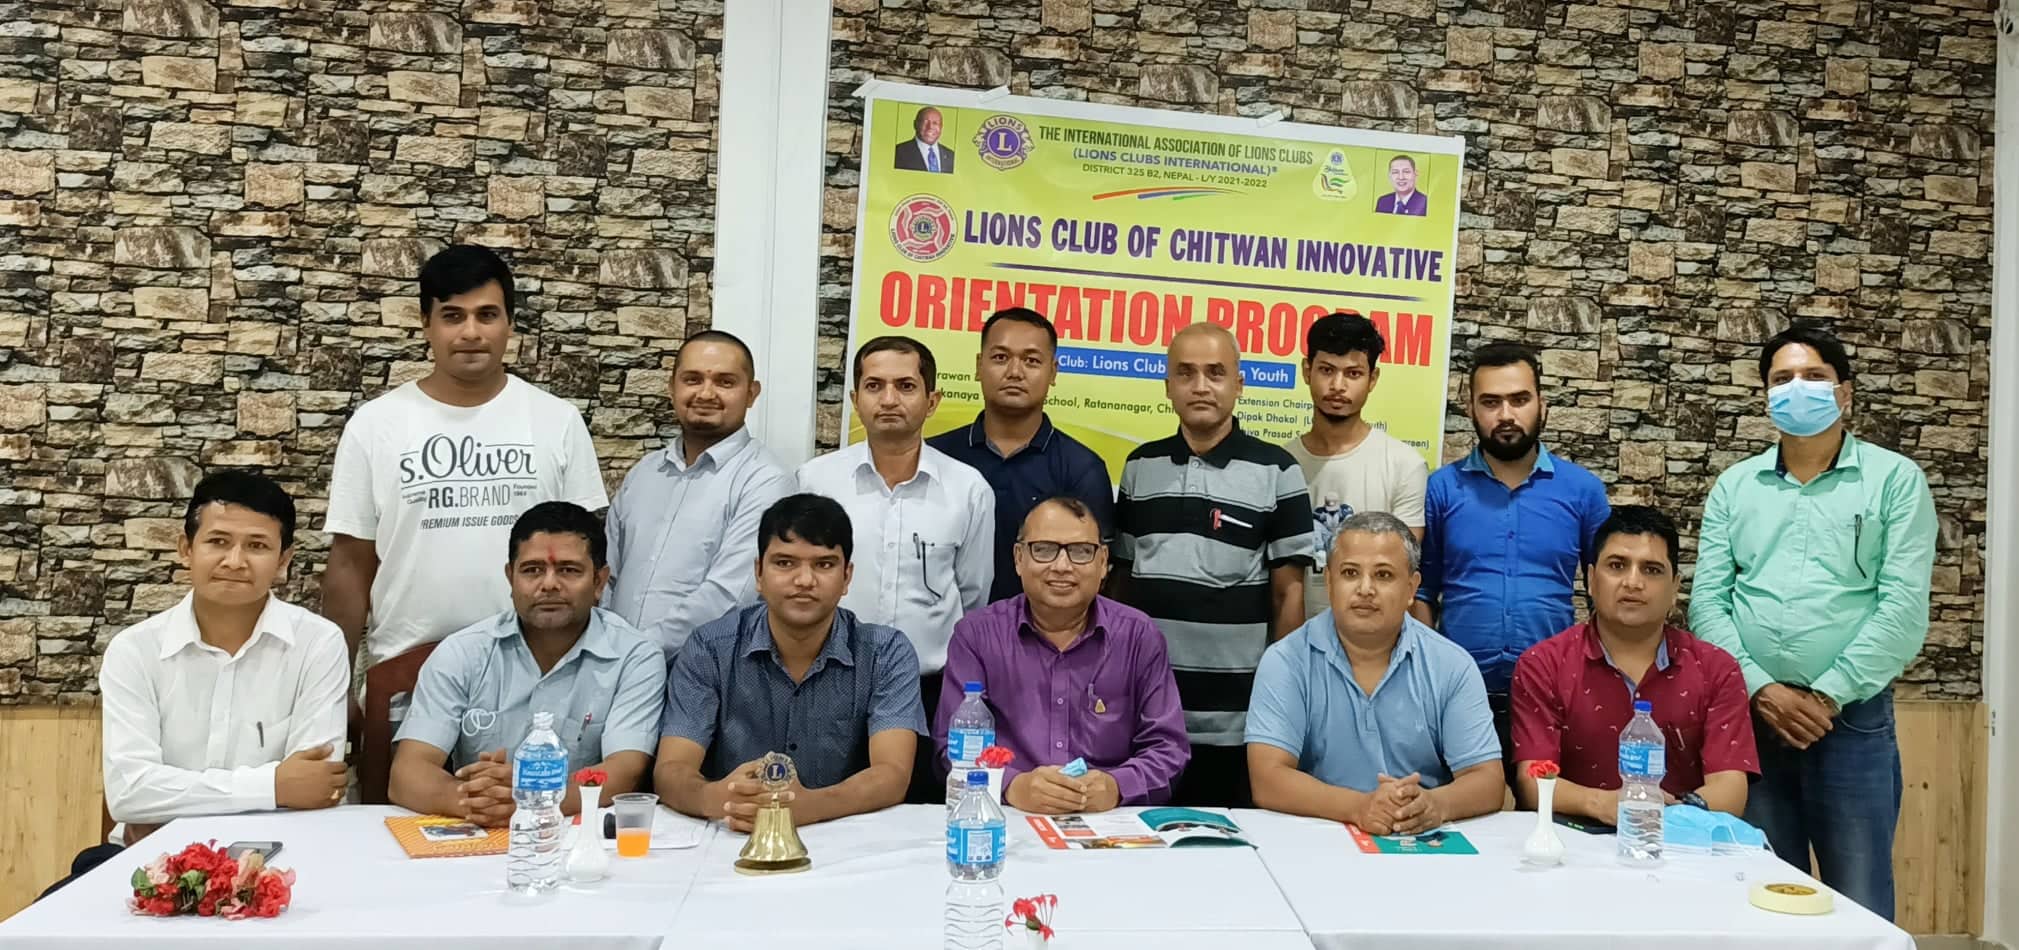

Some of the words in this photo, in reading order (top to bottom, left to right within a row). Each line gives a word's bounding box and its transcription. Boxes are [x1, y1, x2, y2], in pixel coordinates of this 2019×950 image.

[988, 117, 1022, 131] LIONS
[997, 132, 1012, 151] L
[1038, 126, 1061, 142] THE
[1063, 129, 1151, 150] INTERNATIONAL
[1153, 136, 1227, 157] ASSOCIATION
[1228, 144, 1243, 159] OF
[1244, 145, 1276, 162] LIONS
[1278, 149, 1313, 165] CLUBS
[1073, 147, 1117, 162] (LIONS
[1120, 151, 1161, 165] CLUBS
[1082, 163, 1125, 176] DISTRICT
[1126, 166, 1145, 177] 325
[1146, 169, 1162, 179] B2,
[1163, 171, 1194, 182] NEPAL
[1201, 174, 1216, 183] L/Y
[1217, 176, 1268, 188] 2021-2022
[963, 210, 1042, 249] LIONS
[1051, 218, 1118, 255] CLUB
[1127, 225, 1161, 258] OF
[1169, 228, 1288, 270] CHITWAN
[1296, 239, 1444, 282] INNOVATIVE
[1057, 354, 1089, 369] Club:
[1092, 355, 1129, 373] Lions
[1133, 358, 1168, 375] Club
[1251, 367, 1289, 383] Youth
[1238, 396, 1280, 408] Extension
[1282, 398, 1313, 410] Chairp
[400, 433, 537, 484] s.Oliver
[428, 484, 511, 509] RG.BRAND
[462, 515, 489, 528] ISSUE
